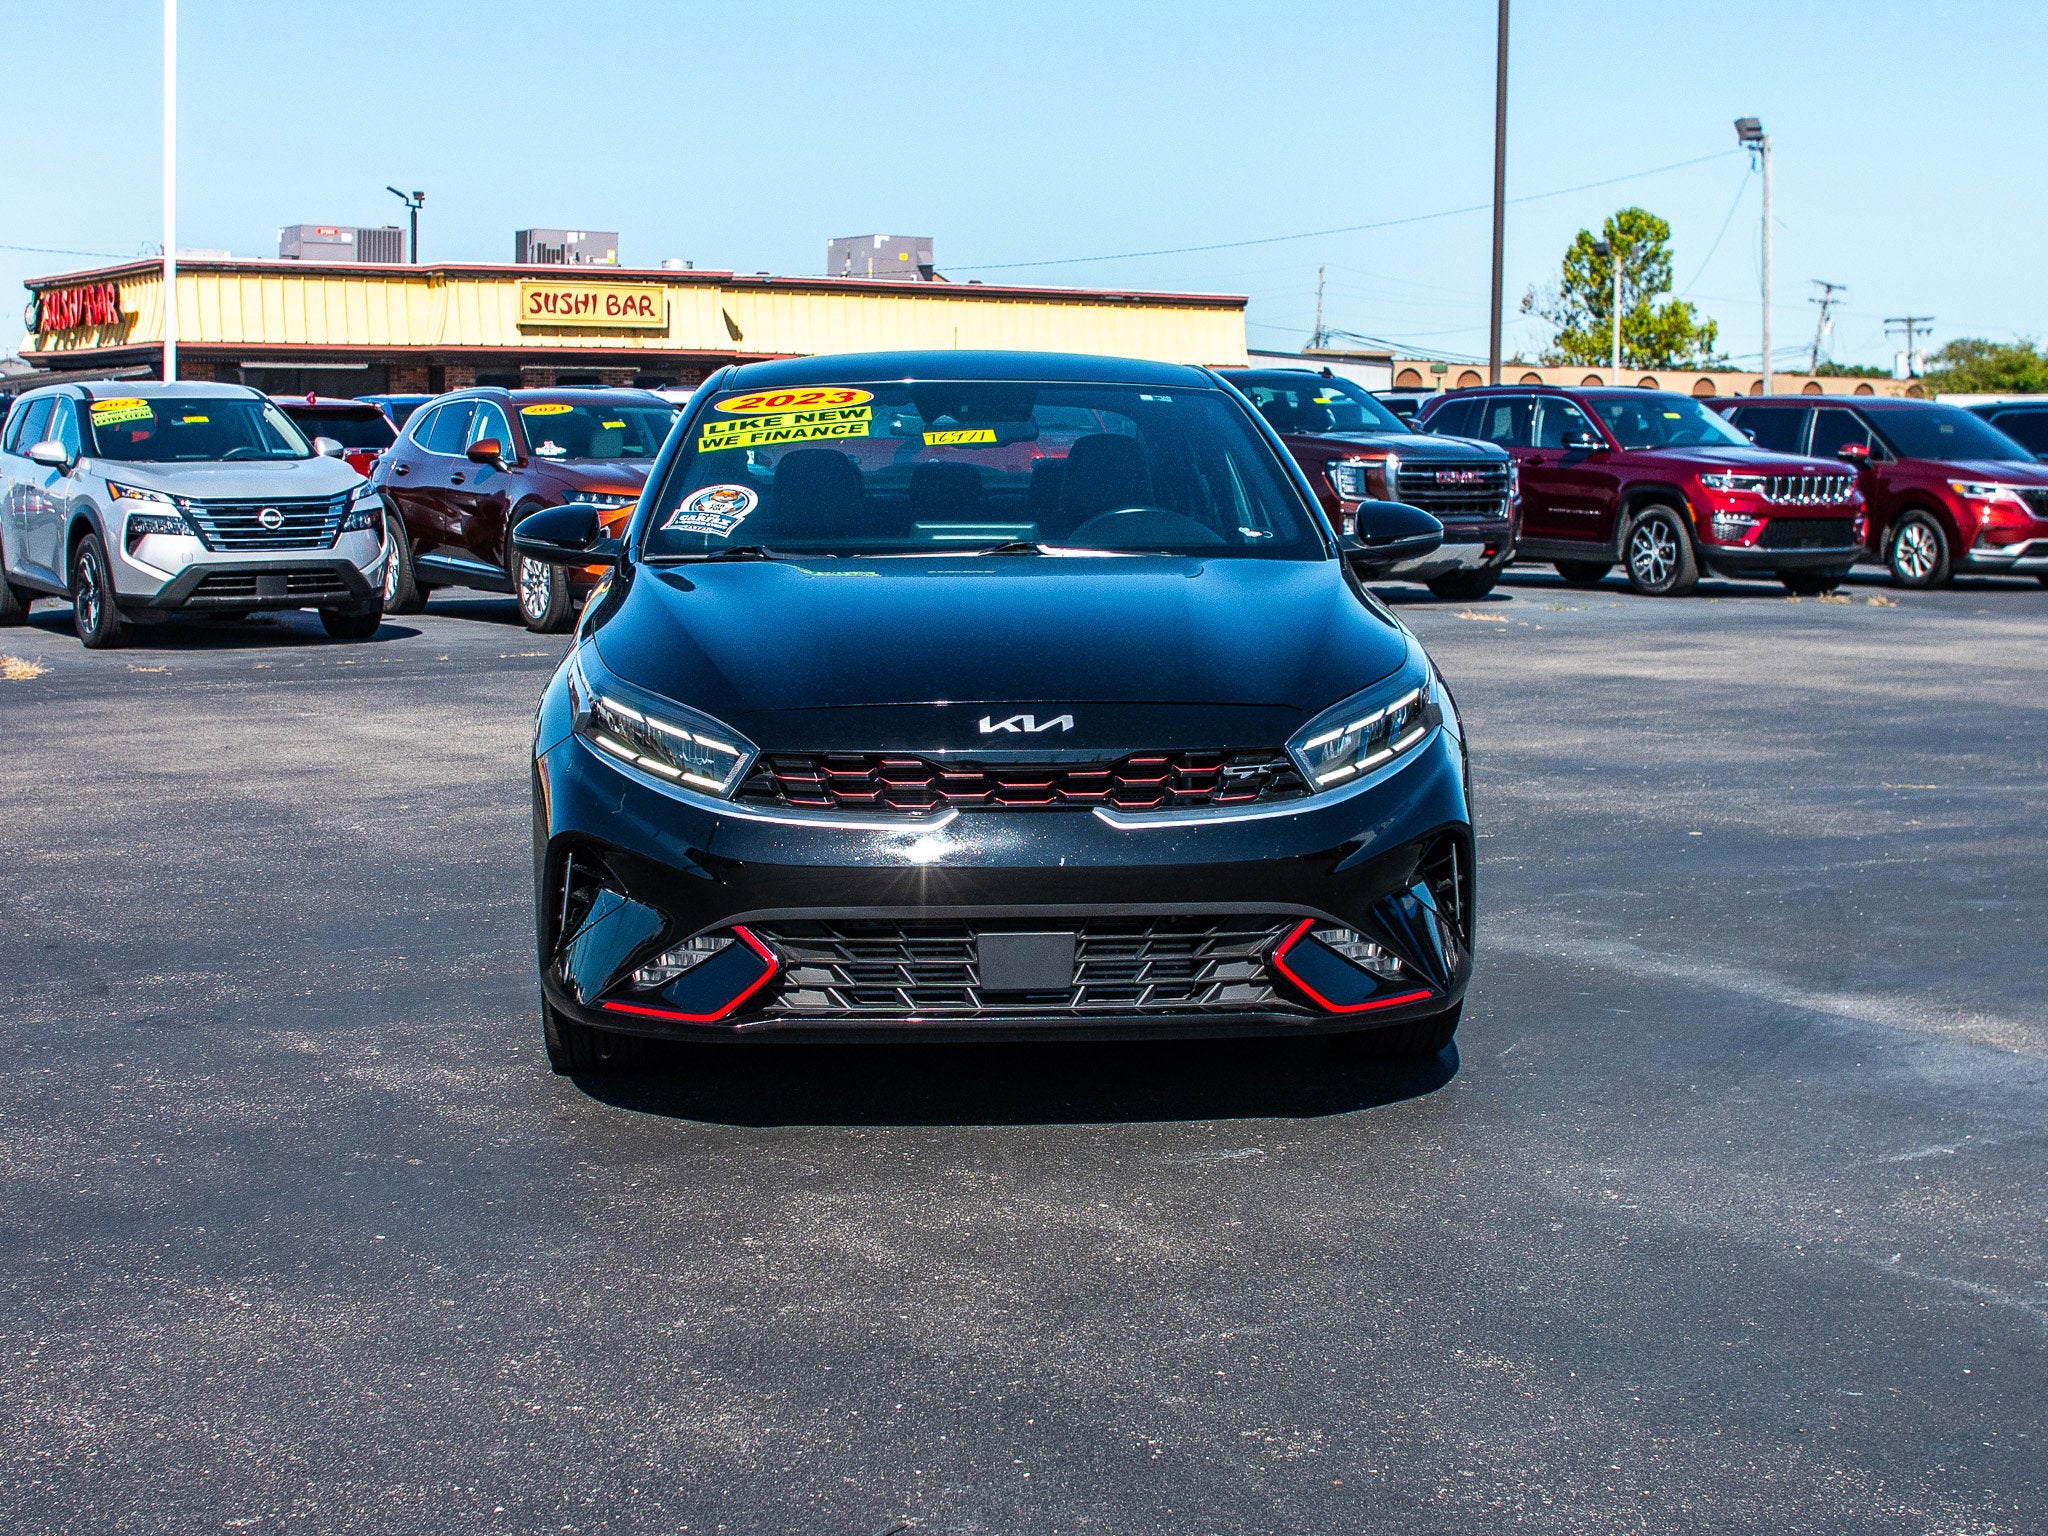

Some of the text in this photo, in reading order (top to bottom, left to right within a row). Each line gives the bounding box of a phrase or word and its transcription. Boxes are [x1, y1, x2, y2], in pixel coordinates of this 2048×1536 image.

[41, 281, 119, 331] SUSHI BAR
[529, 291, 656, 317] SUSHI BAR
[732, 391, 857, 410] 2023
[96, 412, 151, 425] EXTRA CLEAN
[708, 408, 867, 435] LIKE NEW
[702, 423, 864, 450] WE FINANCE
[979, 715, 1074, 734] KIA
